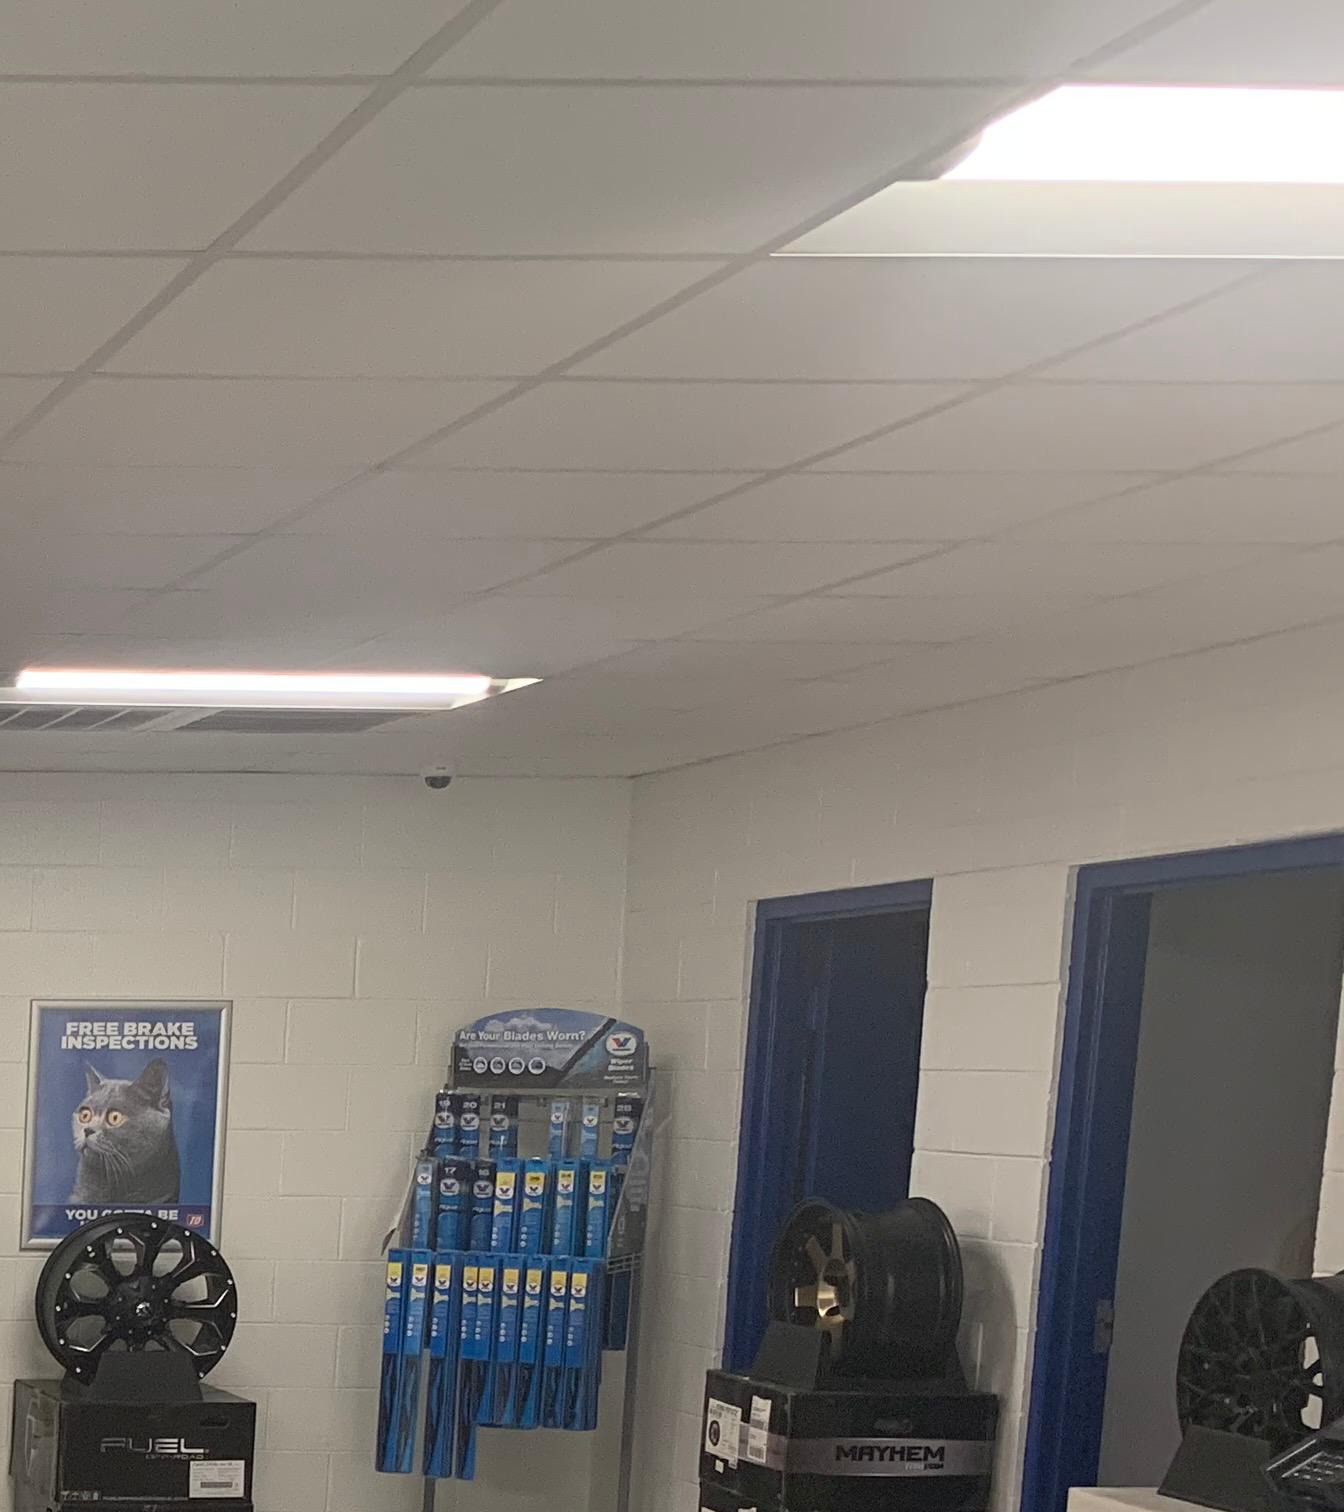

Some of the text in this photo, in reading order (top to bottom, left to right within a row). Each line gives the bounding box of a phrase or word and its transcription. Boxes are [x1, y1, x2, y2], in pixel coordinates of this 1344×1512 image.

[66, 1022, 195, 1036] FREE BRAKE
[459, 1031, 586, 1041] Are Your Blades Worn?
[61, 1036, 198, 1050] INSPECTIONS
[65, 1209, 98, 1221] YOU
[158, 1209, 179, 1221] BE
[100, 1438, 205, 1454] FUEL
[835, 1445, 945, 1462] MAYHEM
